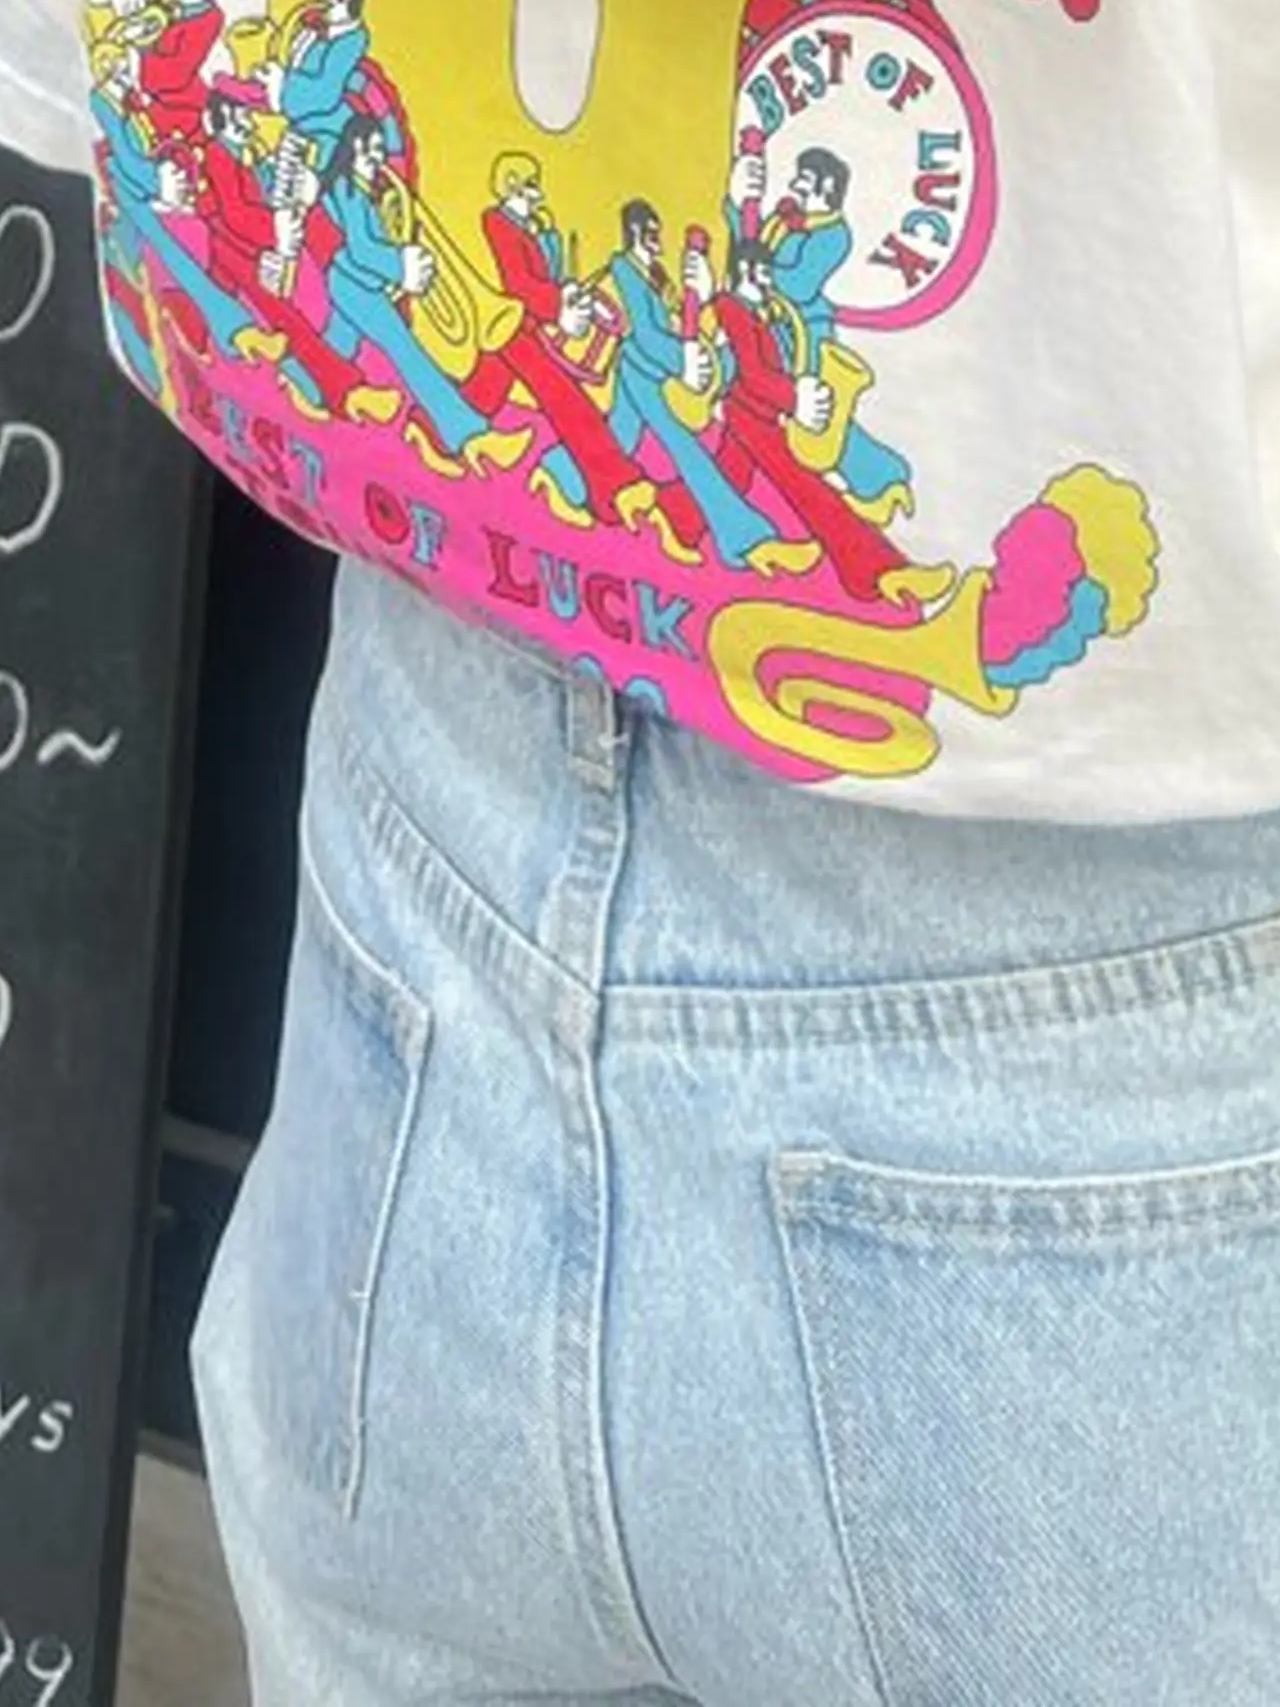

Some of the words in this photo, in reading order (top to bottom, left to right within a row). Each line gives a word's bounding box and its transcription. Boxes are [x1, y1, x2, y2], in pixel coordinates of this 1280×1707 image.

[746, 29, 853, 135] BEST
[865, 52, 935, 113] OF
[867, 128, 963, 289] LUCK
[363, 480, 448, 571] OF
[481, 525, 701, 663] LUCK
